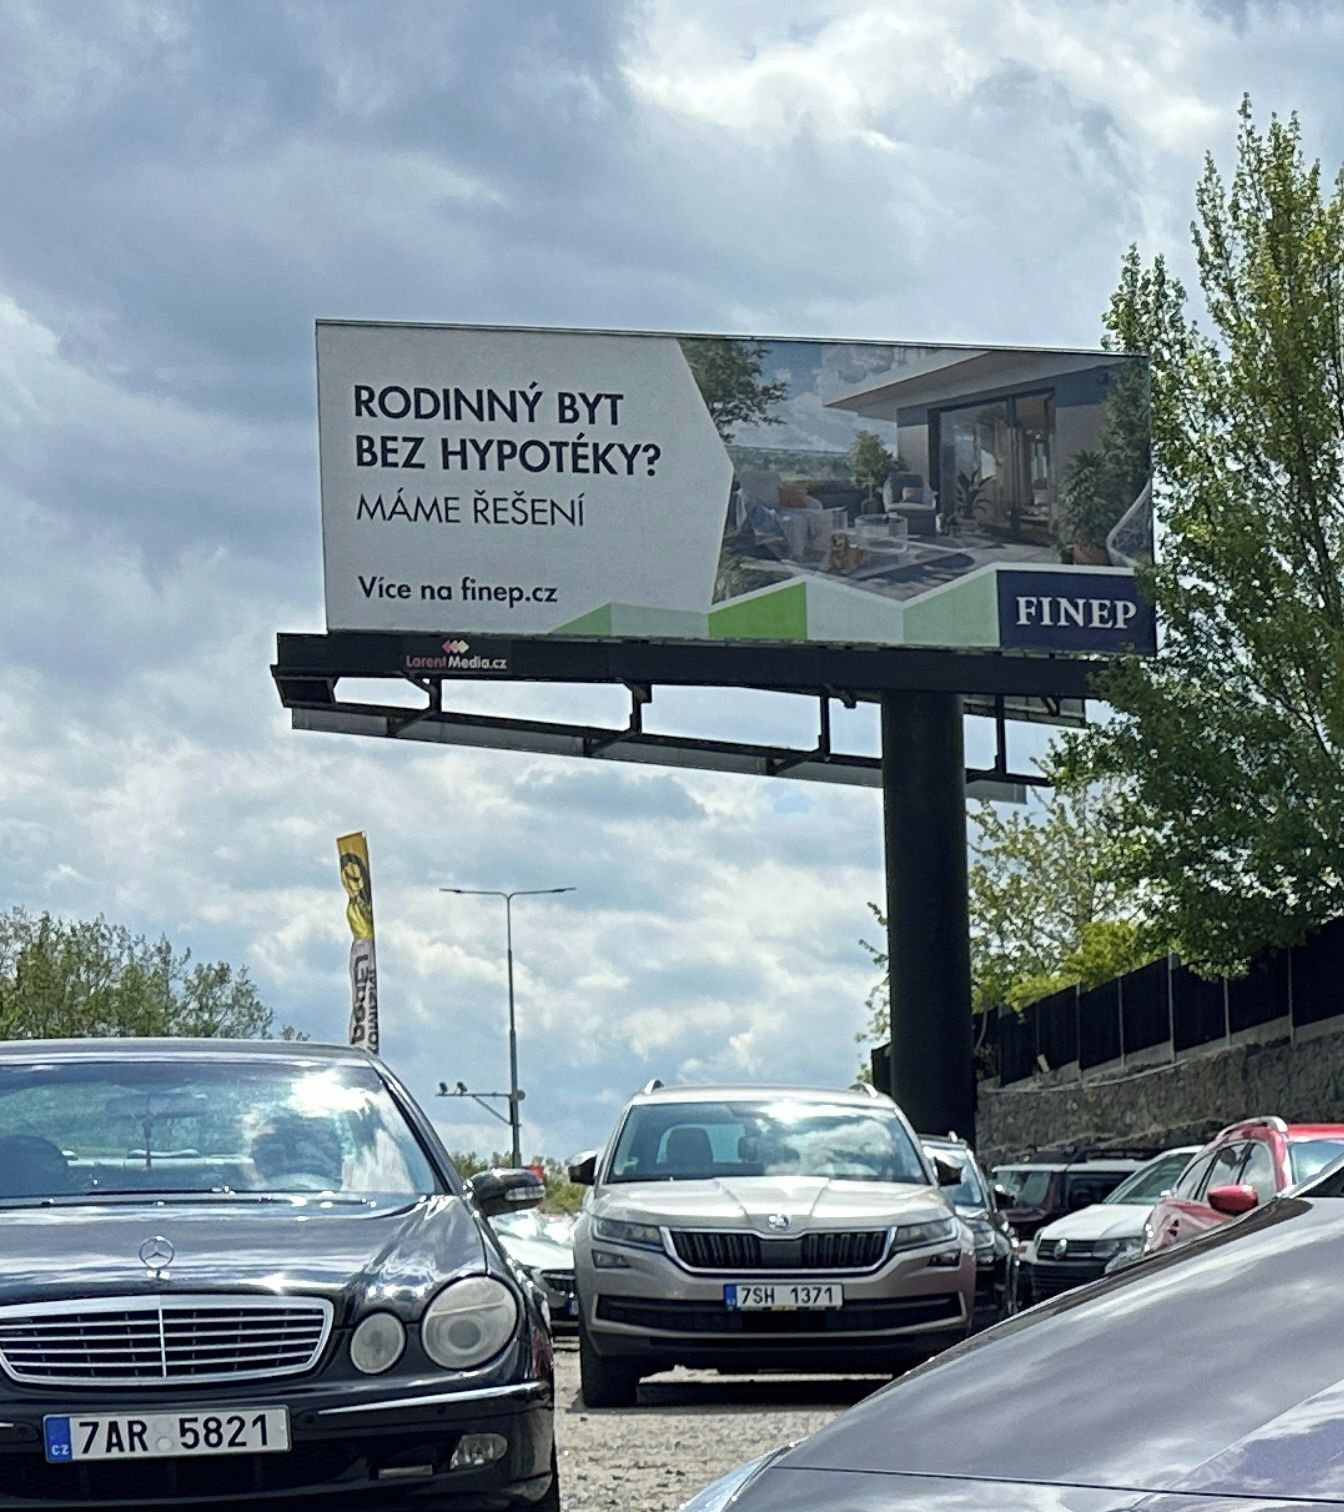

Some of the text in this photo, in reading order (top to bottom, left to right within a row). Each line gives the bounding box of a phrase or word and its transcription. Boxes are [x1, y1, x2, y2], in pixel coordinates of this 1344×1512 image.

[354, 381, 624, 426] RODINNÝ BYT
[356, 432, 662, 477] BEZ HYPOTÉKY?
[356, 488, 586, 527] MÁME ŘEŠENÍ
[358, 575, 559, 608] Více na finep.cz
[1015, 596, 1137, 629] FINEP
[741, 1286, 833, 1304] 7SH 1371
[51, 1444, 69, 1456] CZ
[79, 1414, 268, 1454] 7AR 5821
